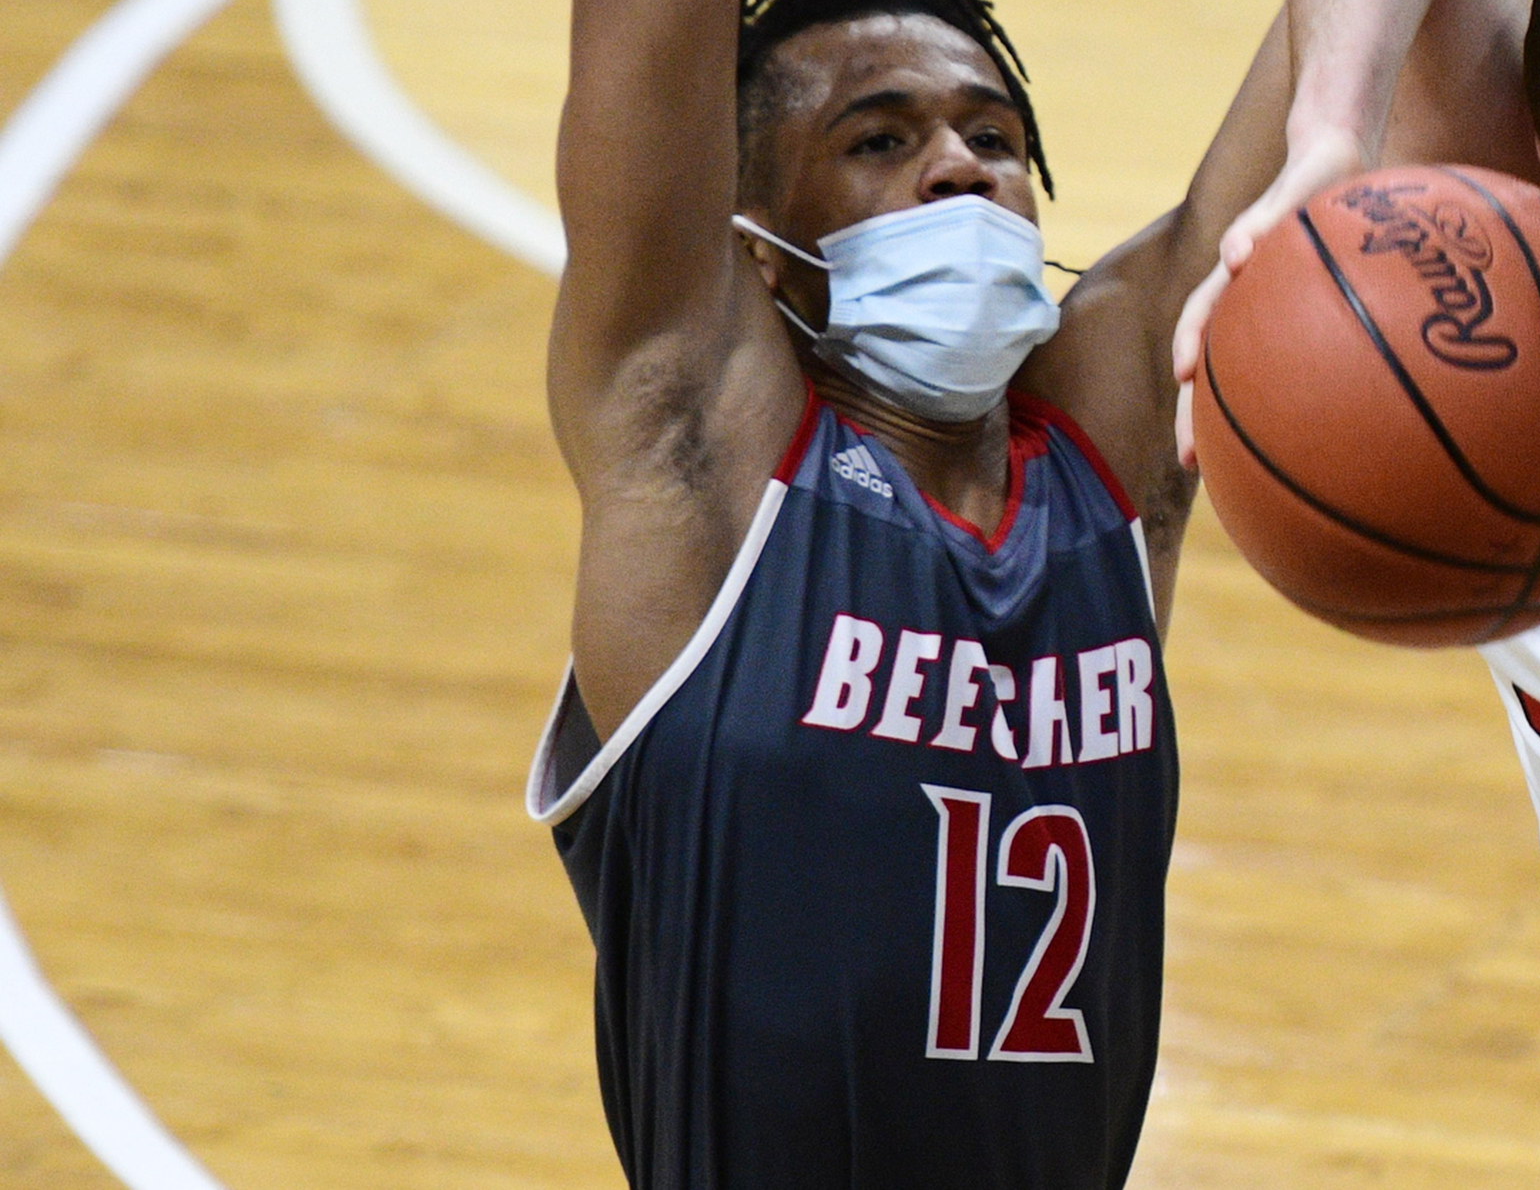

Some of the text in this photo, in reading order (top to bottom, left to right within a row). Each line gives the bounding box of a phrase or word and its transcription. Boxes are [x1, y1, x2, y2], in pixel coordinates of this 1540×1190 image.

[831, 457, 893, 499] adidas
[799, 612, 1155, 769] BEECHER
[919, 782, 1097, 1063] 12
